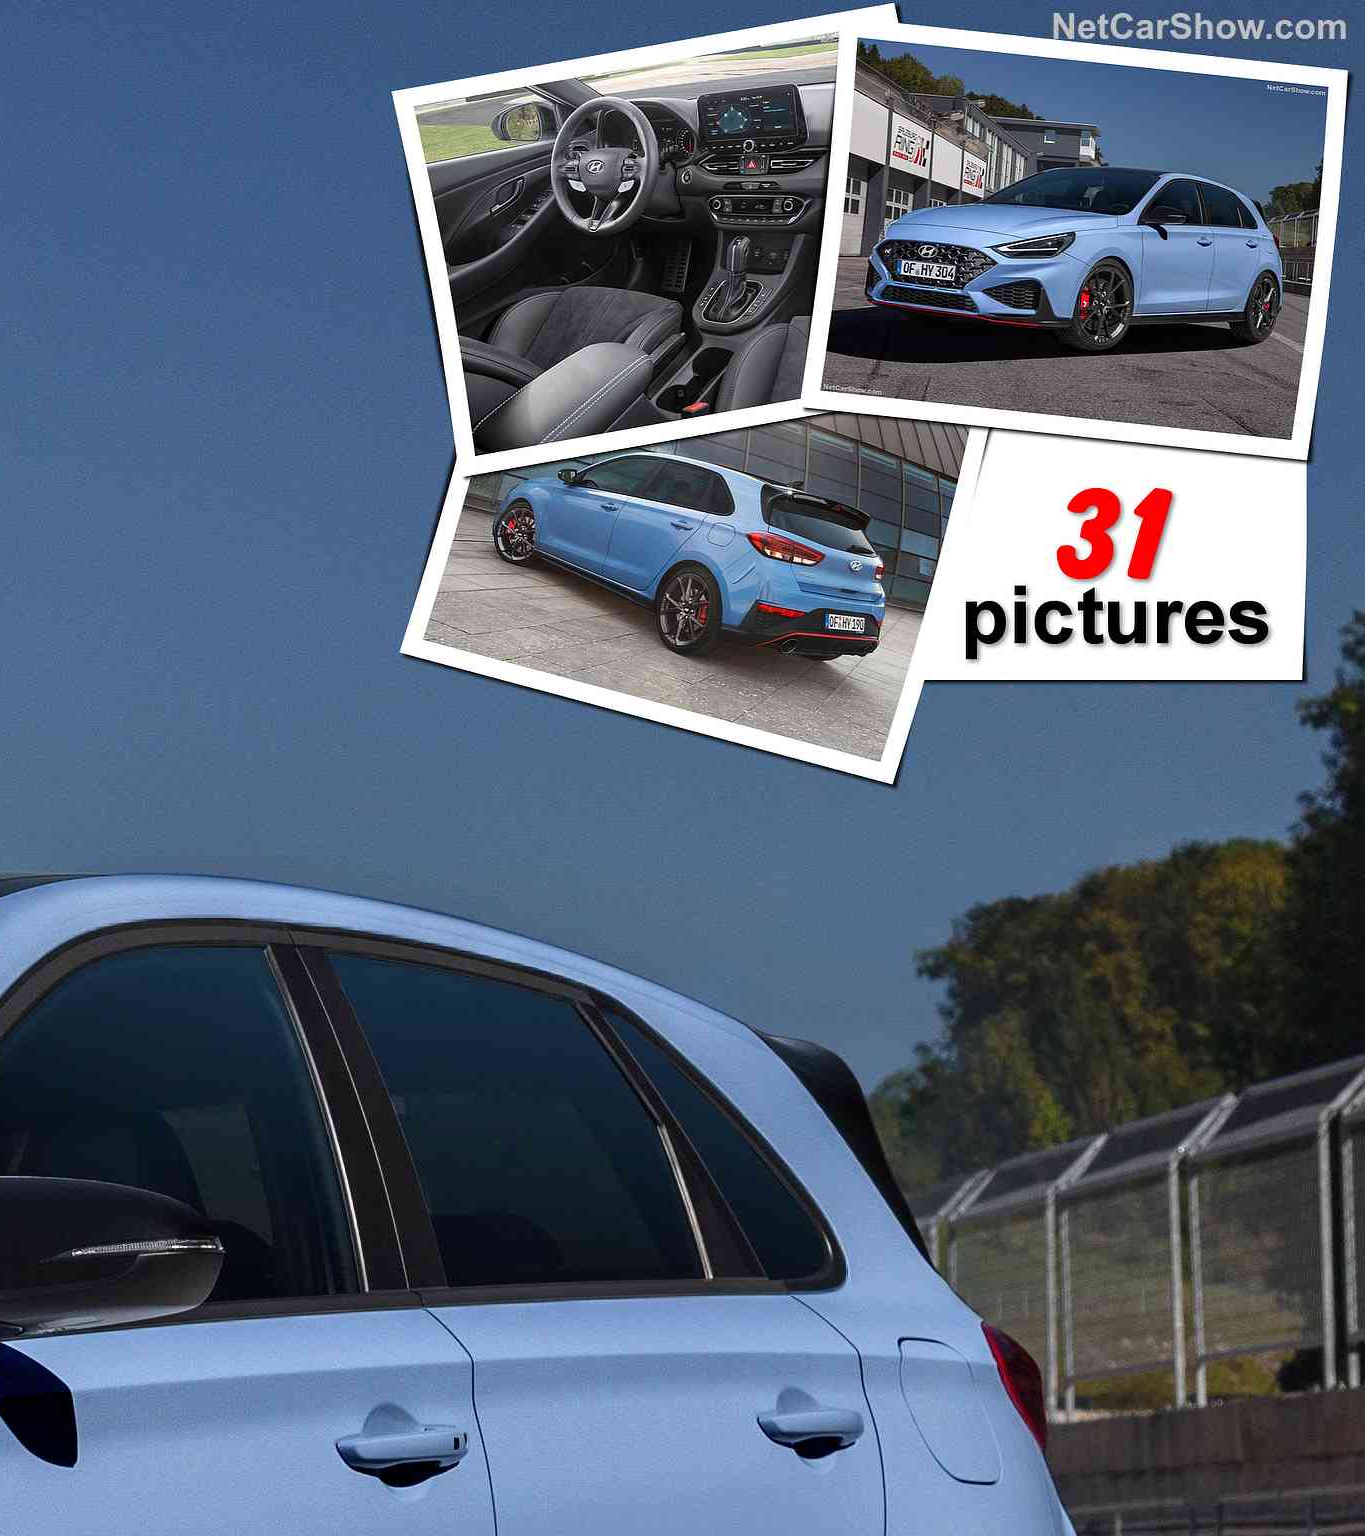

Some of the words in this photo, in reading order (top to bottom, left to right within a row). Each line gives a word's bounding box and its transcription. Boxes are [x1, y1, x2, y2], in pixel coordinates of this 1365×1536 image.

[903, 262, 916, 274] OF
[921, 263, 934, 277] HY
[935, 265, 955, 280] 304
